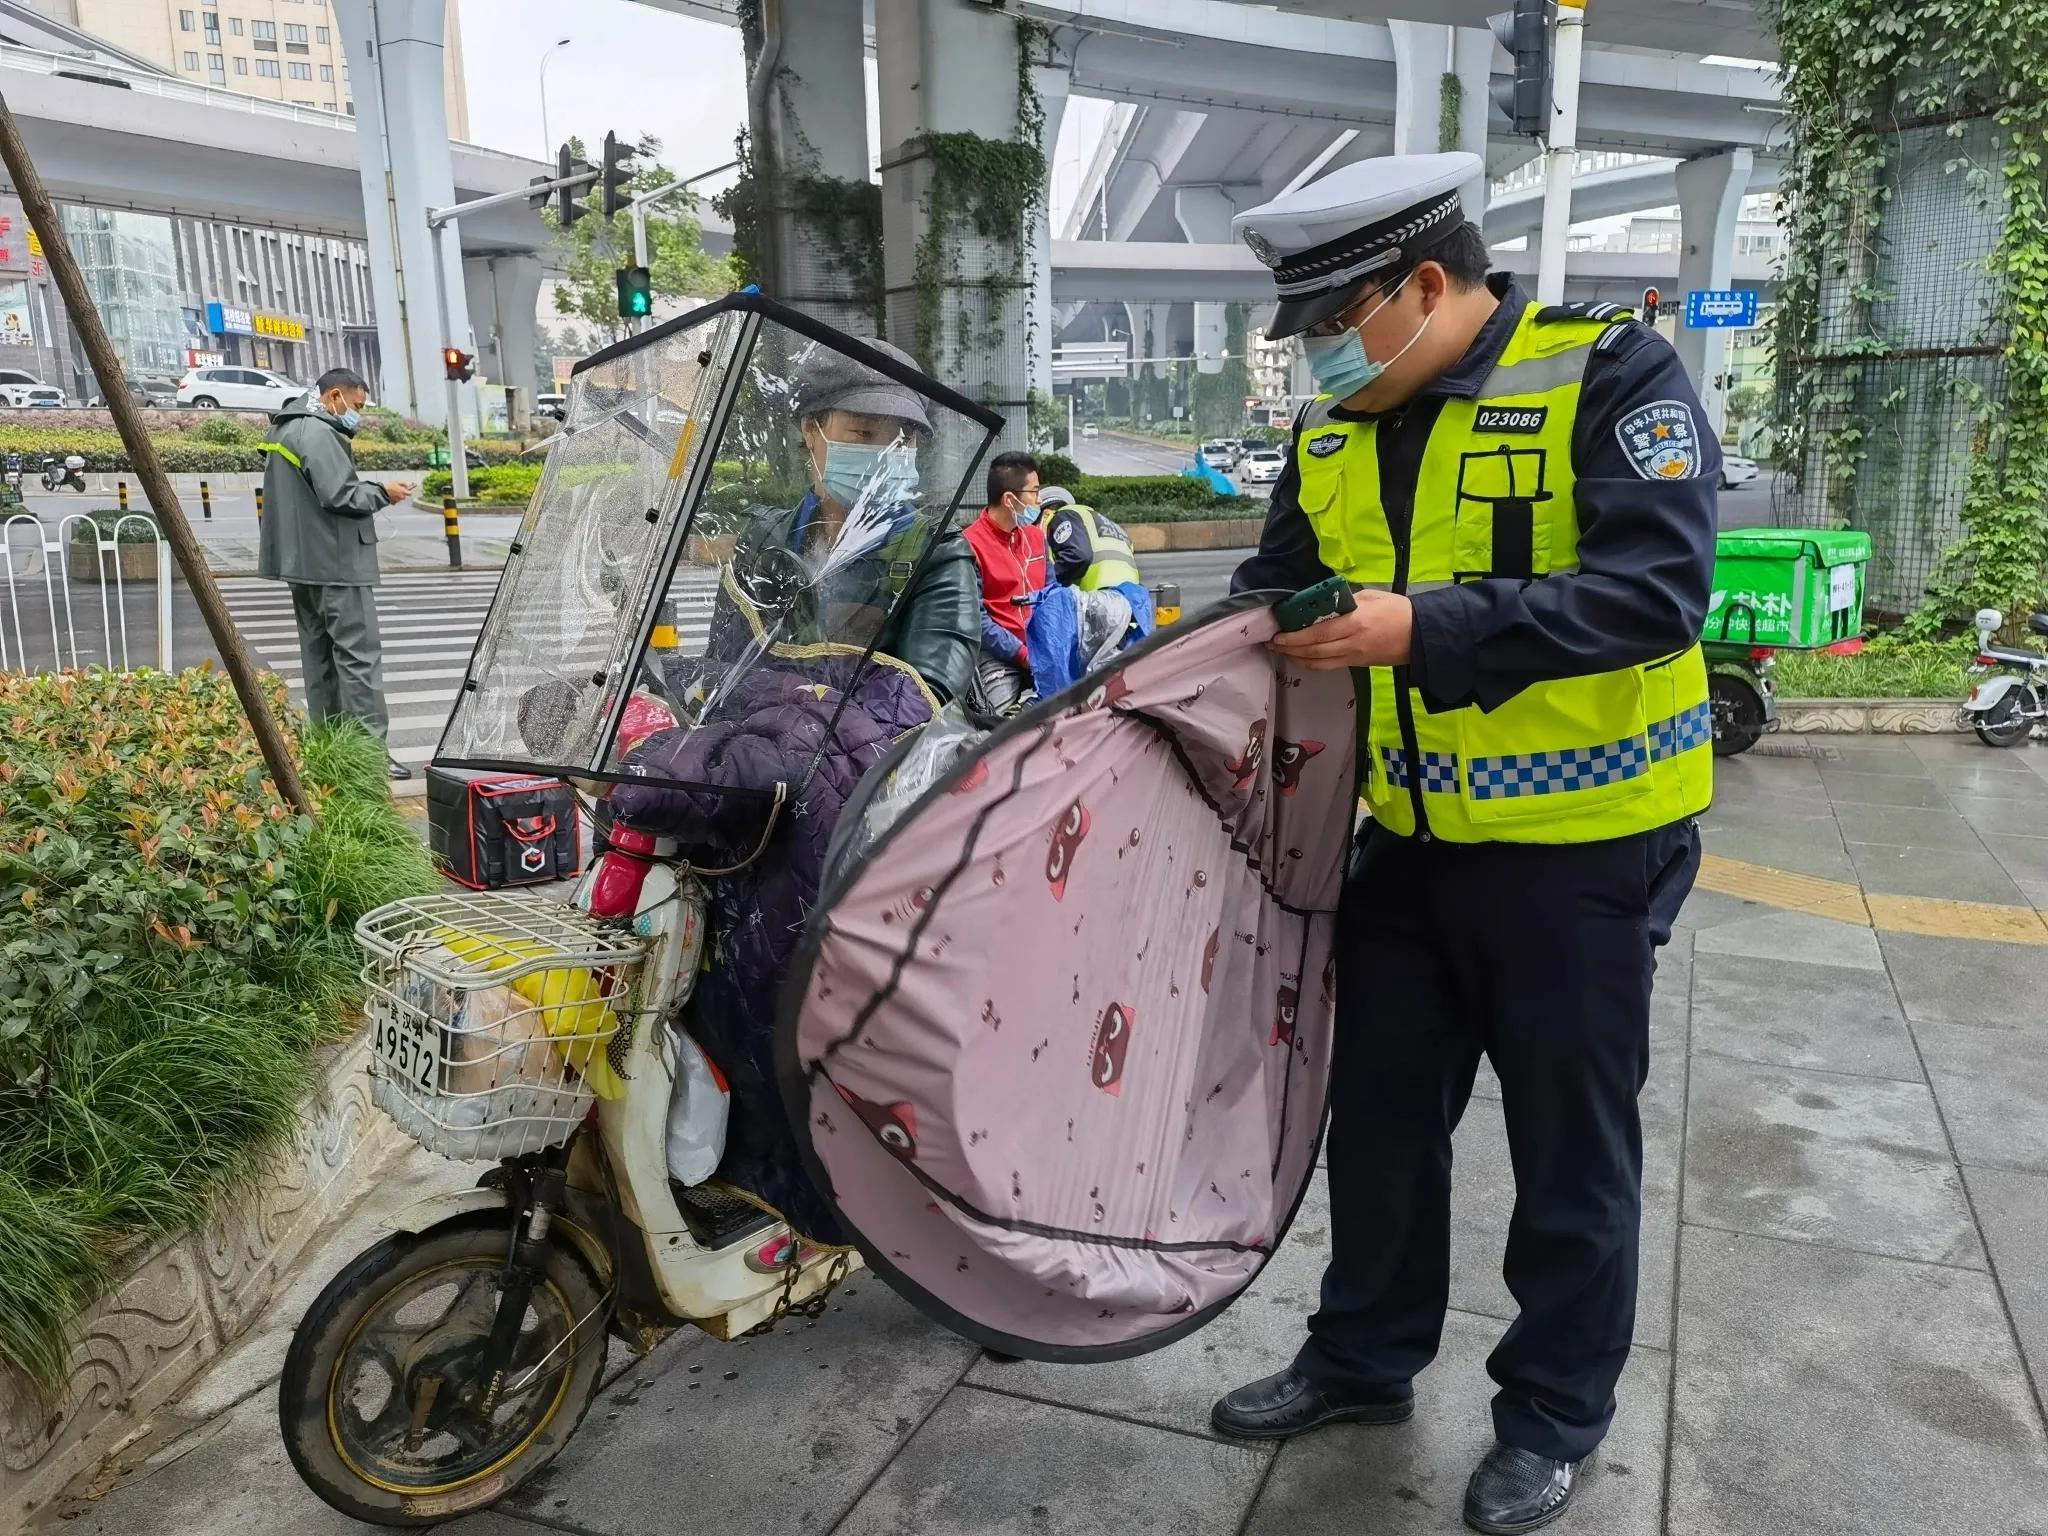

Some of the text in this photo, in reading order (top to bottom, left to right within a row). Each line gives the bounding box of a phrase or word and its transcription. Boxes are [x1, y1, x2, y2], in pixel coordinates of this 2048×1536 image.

[1479, 412, 1541, 427] 023086
[1624, 407, 1687, 436] 中华人民共和国
[1651, 440, 1679, 454] POLICE
[375, 1018, 433, 1088] A9572
